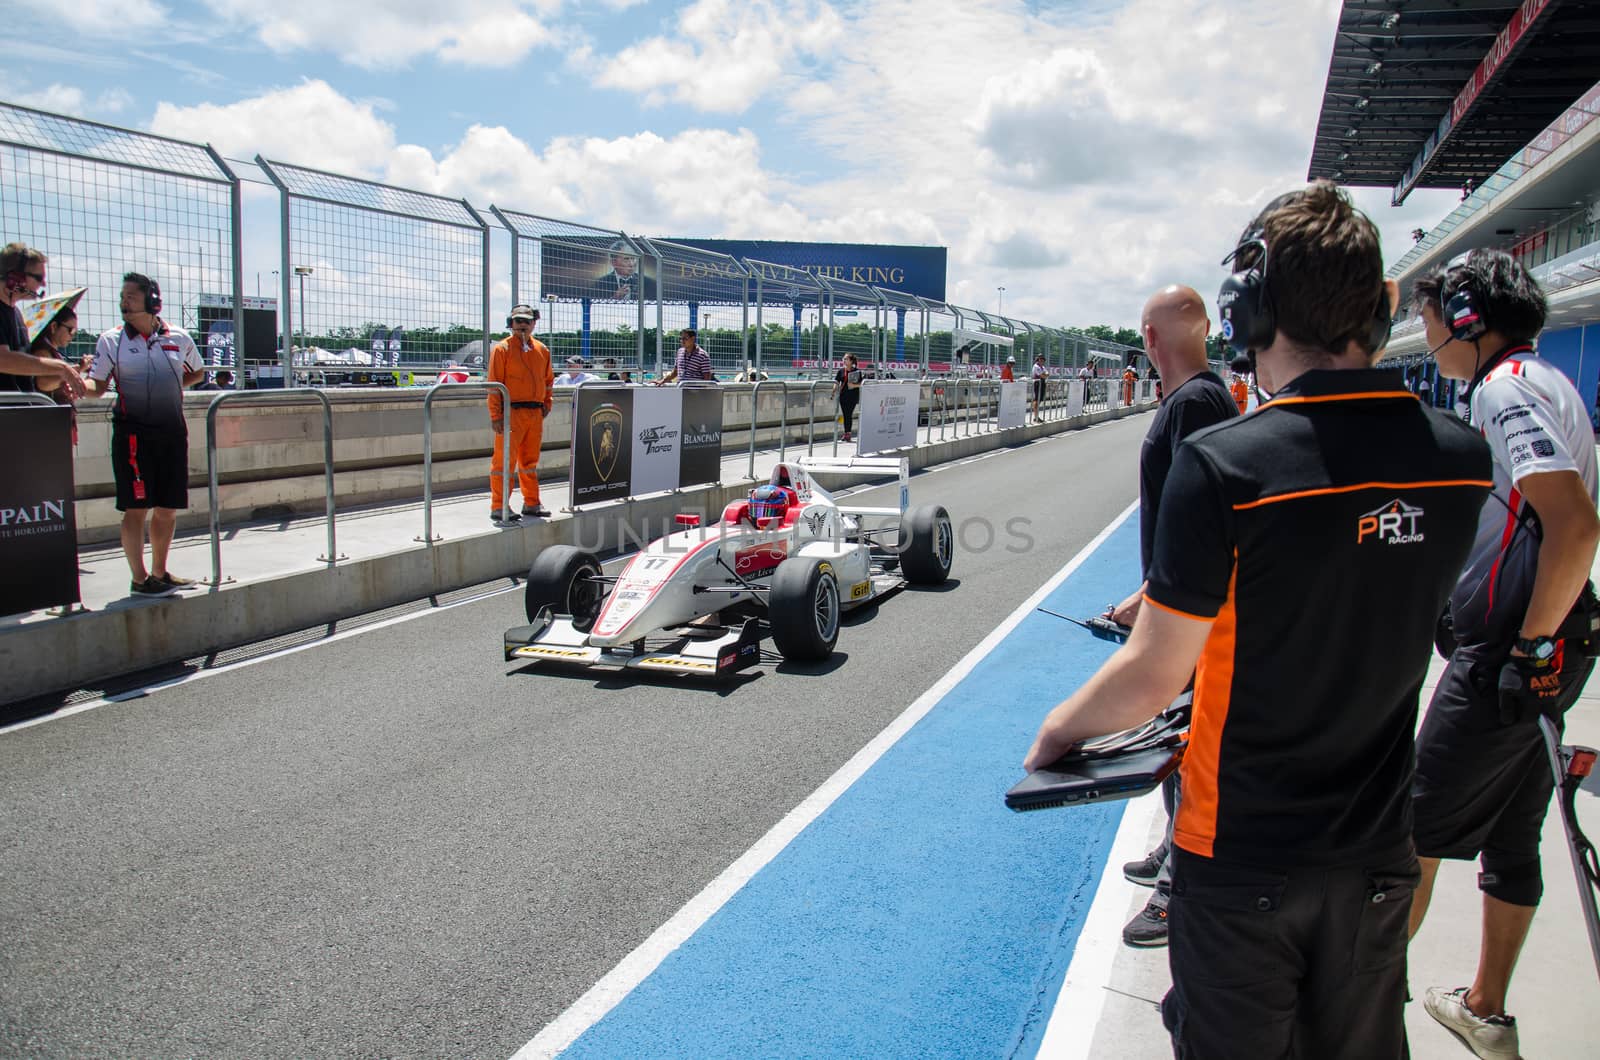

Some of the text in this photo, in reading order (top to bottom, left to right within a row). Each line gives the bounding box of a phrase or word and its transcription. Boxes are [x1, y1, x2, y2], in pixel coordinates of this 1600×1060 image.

[851, 266, 905, 284] KING
[683, 431, 720, 445] BLANCPAIN
[1357, 510, 1424, 544] PRT
[1388, 533, 1425, 544] RACING
[644, 558, 669, 570] 17
